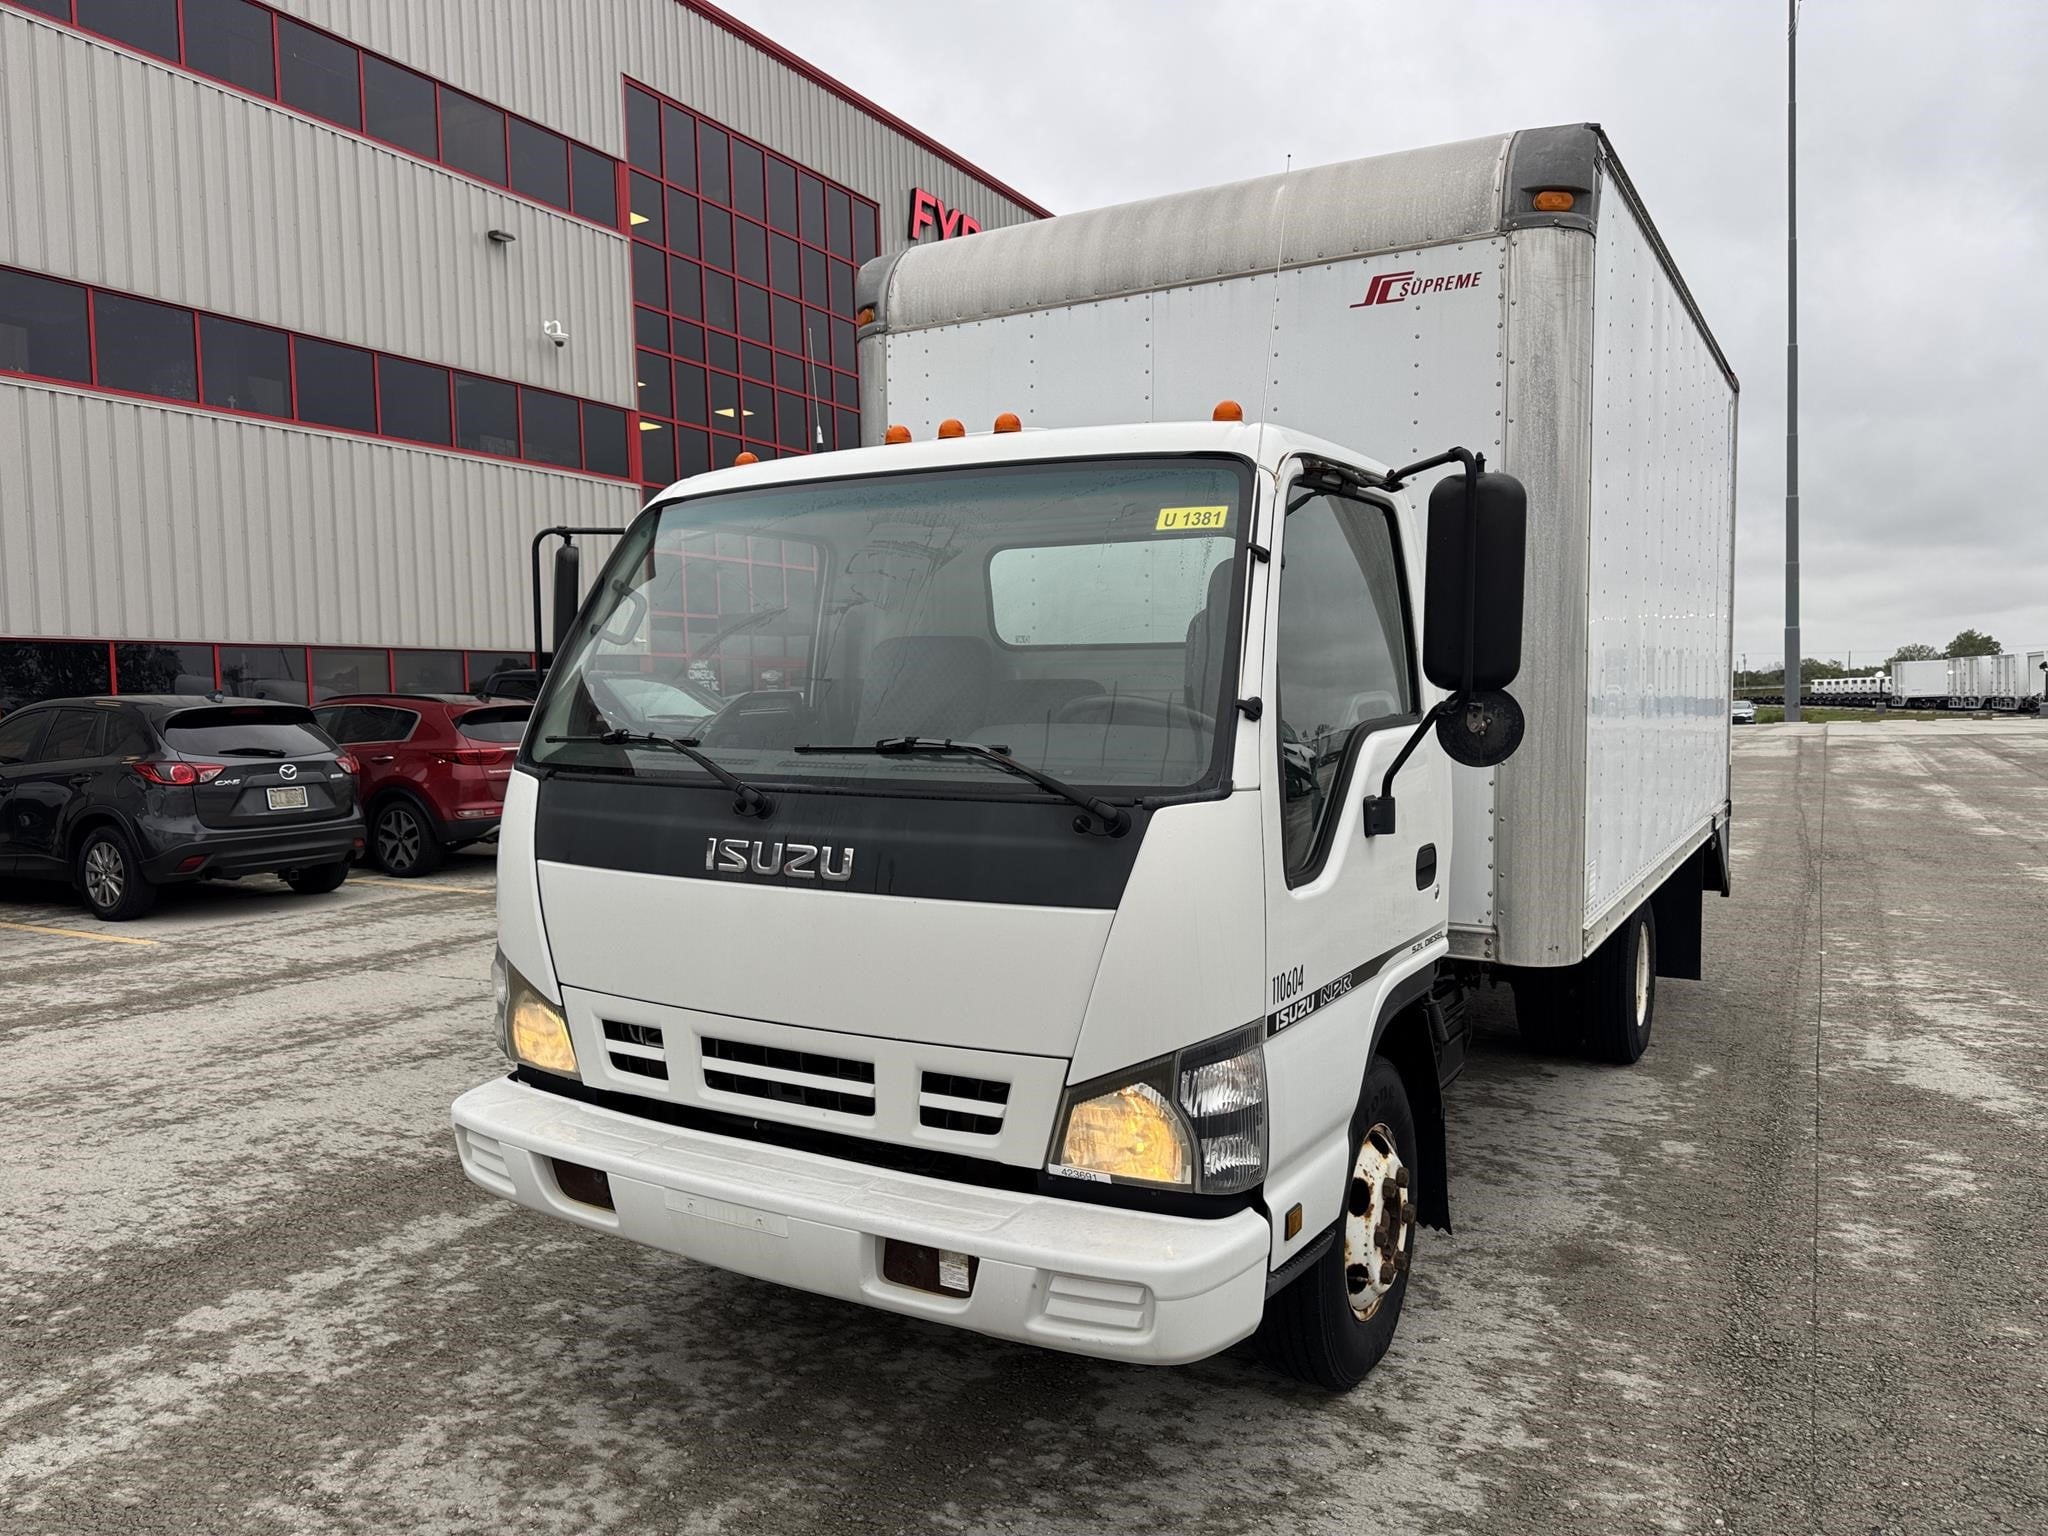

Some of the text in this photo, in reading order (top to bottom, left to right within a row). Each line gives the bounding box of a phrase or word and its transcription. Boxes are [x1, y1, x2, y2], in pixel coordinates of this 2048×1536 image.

[1400, 271, 1482, 297] SUPREME
[1164, 511, 1221, 527] U 1381
[705, 837, 854, 881] ISUZU
[1272, 964, 1304, 1005] 110604
[1275, 973, 1353, 1031] ISUZU NPR
